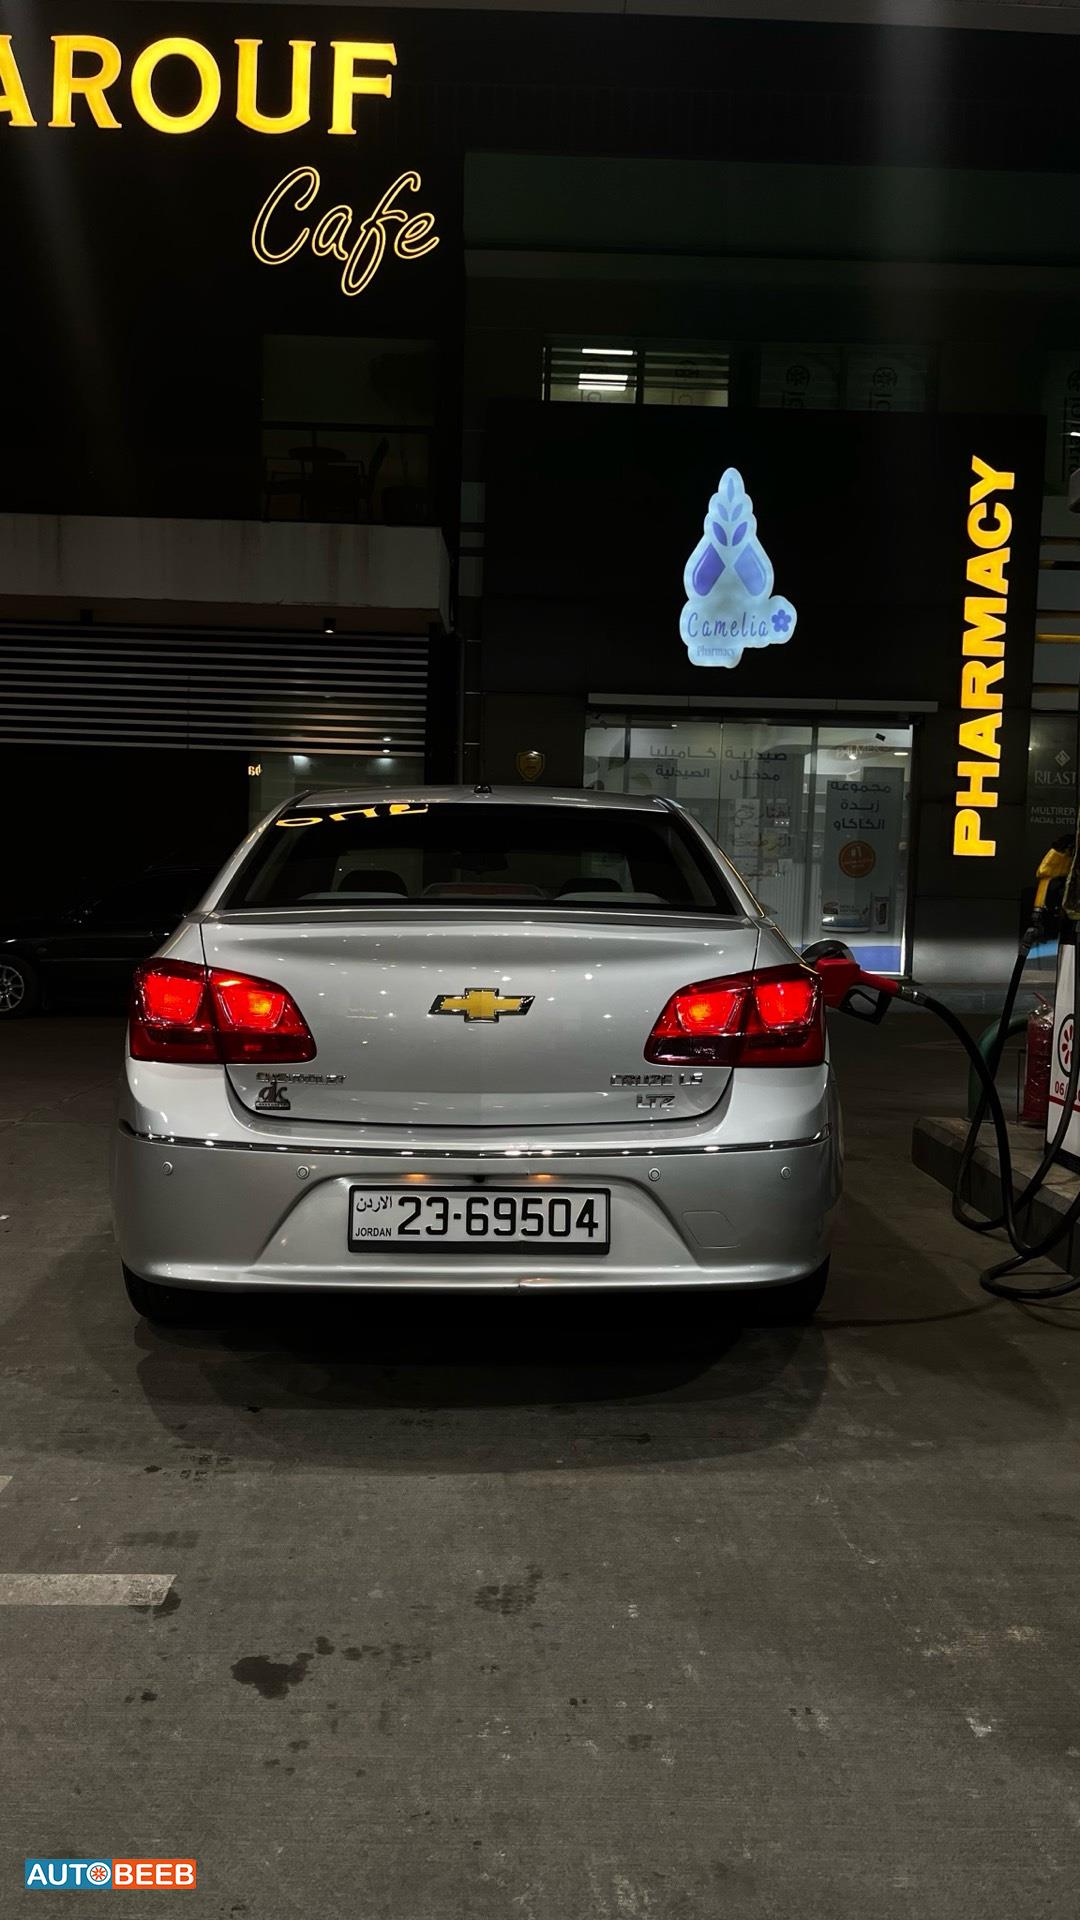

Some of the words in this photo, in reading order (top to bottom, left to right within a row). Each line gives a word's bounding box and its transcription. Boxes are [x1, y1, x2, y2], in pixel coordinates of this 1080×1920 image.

[251, 165, 440, 297] Cafe
[687, 611, 769, 638] Camelia
[953, 455, 1016, 857] PHARMACY
[610, 1073, 673, 1087] CRUZE
[636, 1094, 676, 1109] LTZ
[398, 1196, 599, 1237] 23-69504
[355, 1227, 392, 1237] JORDAN
